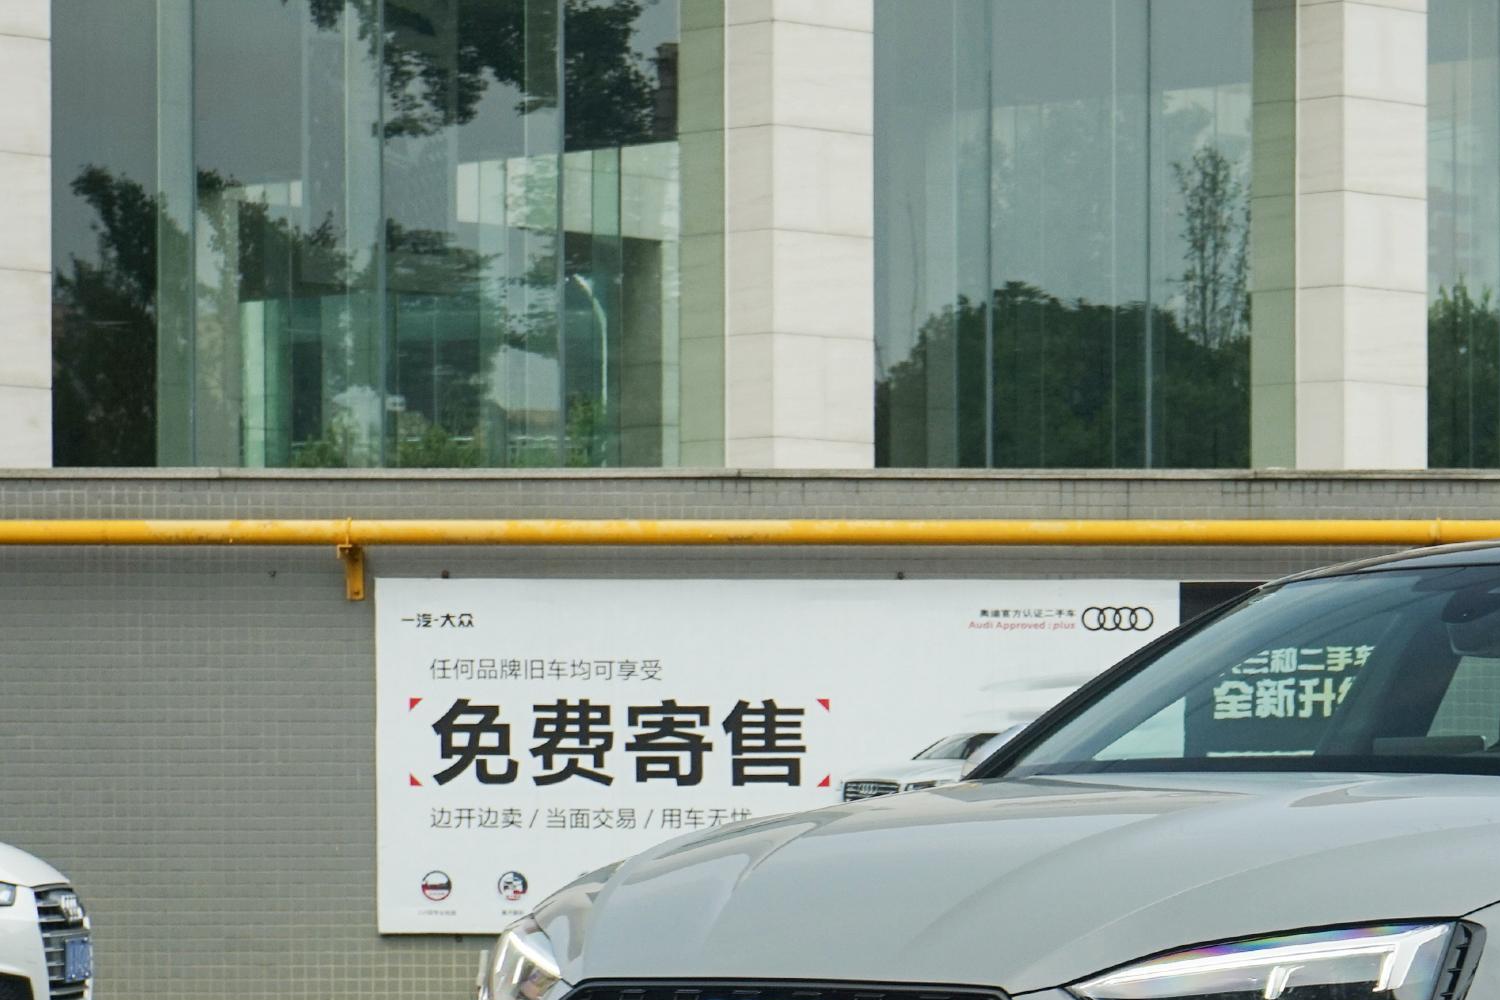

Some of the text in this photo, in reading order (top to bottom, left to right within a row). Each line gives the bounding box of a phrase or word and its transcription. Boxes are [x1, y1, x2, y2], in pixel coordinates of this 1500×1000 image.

[969, 621, 993, 630] Audi
[996, 621, 1046, 632] Approved
[429, 659, 664, 681] 任何品牌旧车均可享受
[431, 698, 807, 787] 免费寄售
[430, 808, 523, 829] 边开边卖
[546, 808, 637, 829] 当面交易
